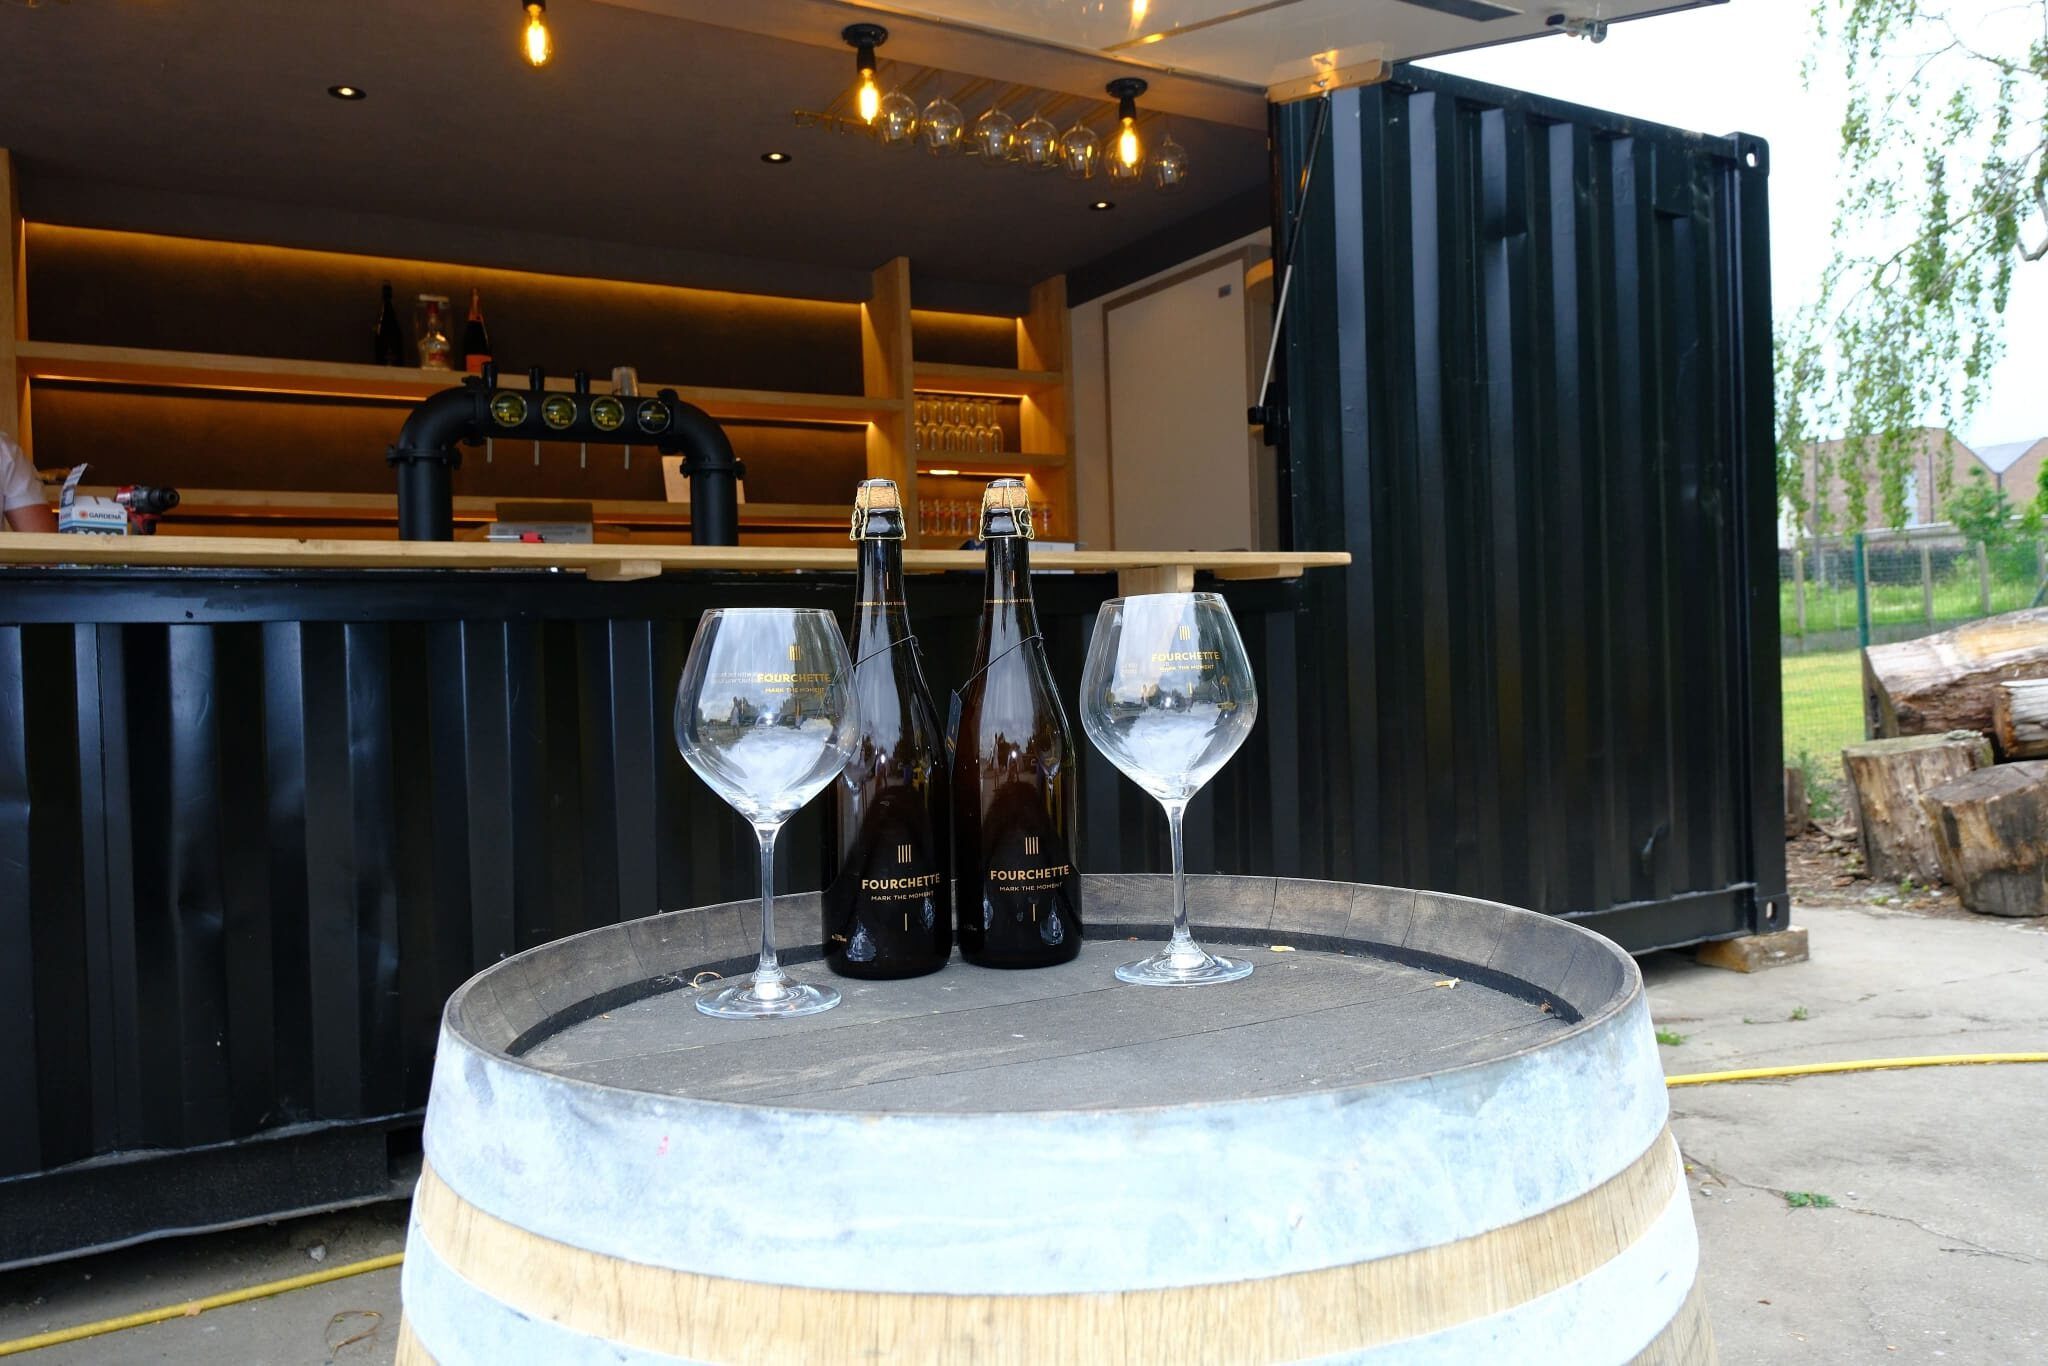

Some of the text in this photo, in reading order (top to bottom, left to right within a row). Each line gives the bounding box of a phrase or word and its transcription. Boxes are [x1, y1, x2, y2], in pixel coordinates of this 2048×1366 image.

[89, 511, 122, 520] GARDENA
[1152, 650, 1221, 662] FOURCHETTE
[757, 672, 832, 683] FOURCHETTE
[990, 864, 1070, 881] FOURCHETTE
[862, 872, 940, 890] FOURCHETTE
[1037, 881, 1063, 890] MOMENT
[908, 890, 934, 900] MOMENT
